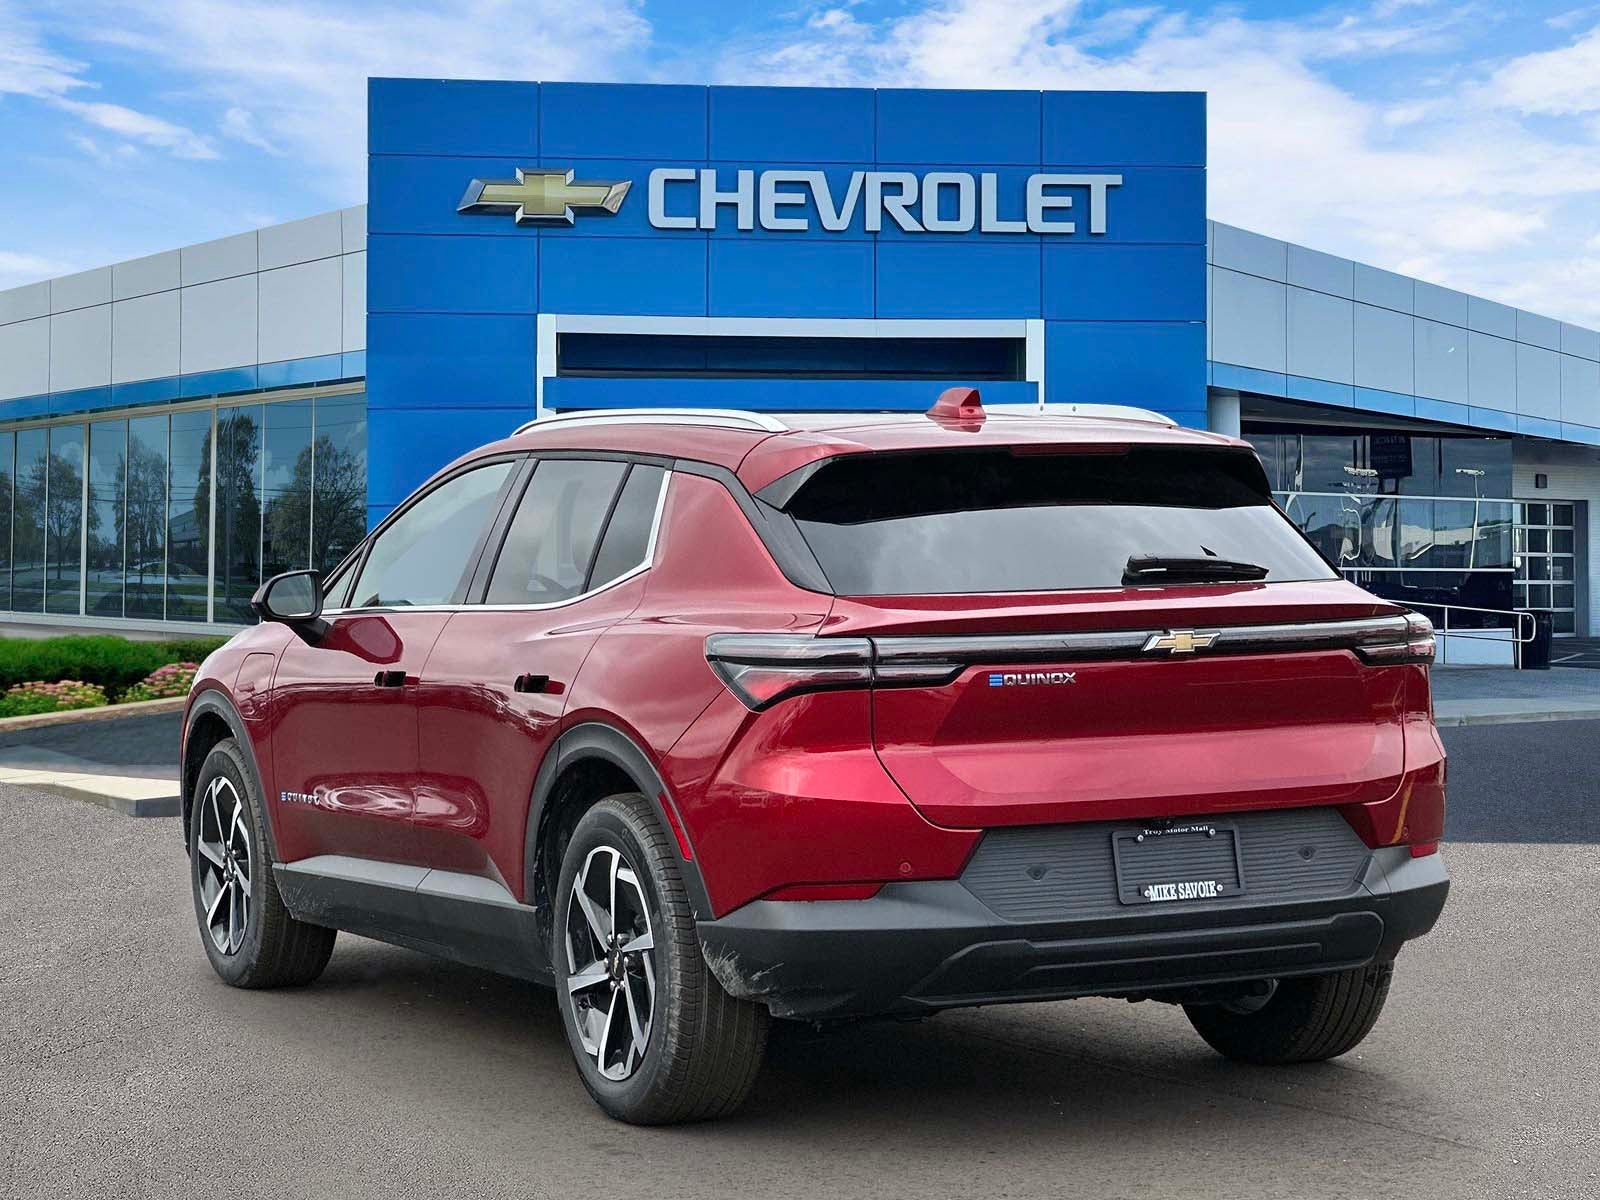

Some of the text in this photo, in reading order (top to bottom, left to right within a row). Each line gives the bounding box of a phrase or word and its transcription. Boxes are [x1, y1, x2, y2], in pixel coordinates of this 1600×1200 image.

[648, 167, 1123, 234] CHEVROLET
[989, 672, 1076, 687] EQUINOX
[1149, 881, 1217, 901] MIKE SAVOIE
